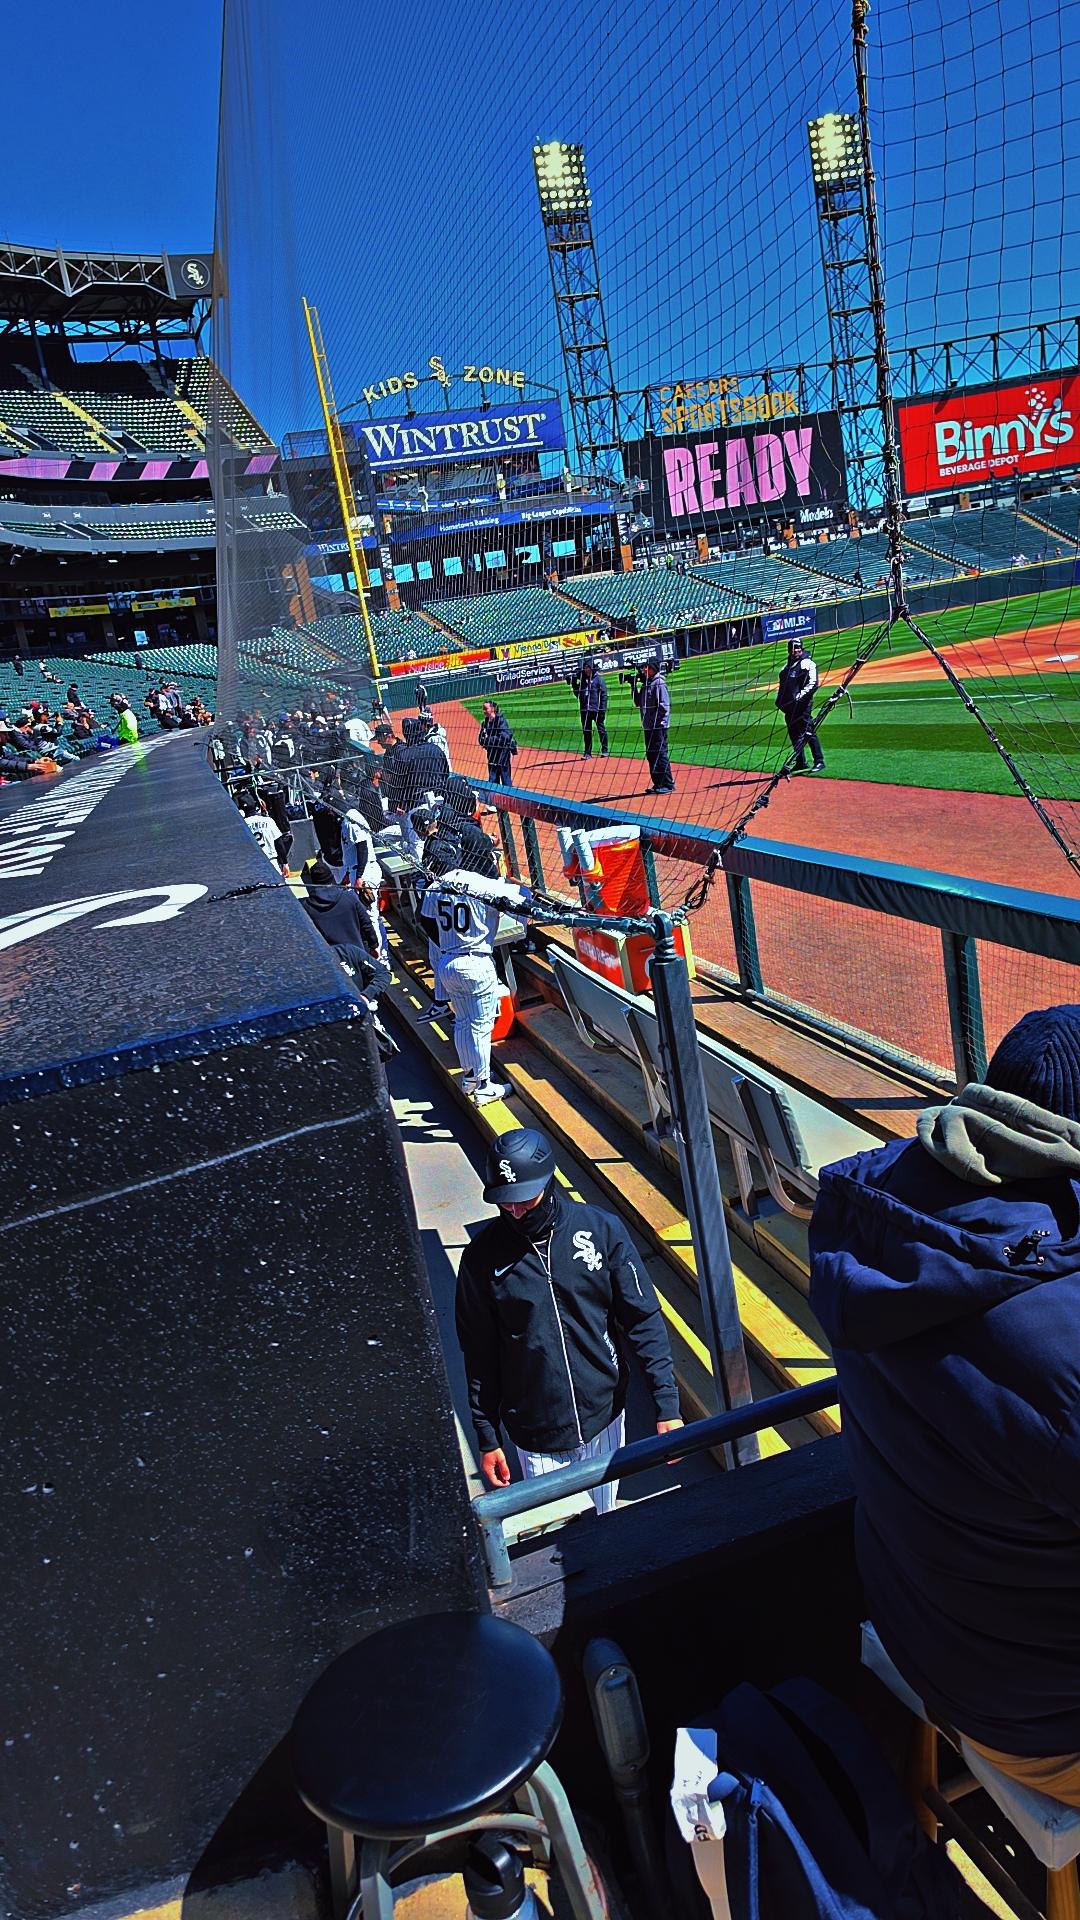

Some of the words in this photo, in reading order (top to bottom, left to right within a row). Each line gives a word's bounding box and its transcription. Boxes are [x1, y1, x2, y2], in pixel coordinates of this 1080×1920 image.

[362, 372, 419, 404] KIDS
[463, 365, 526, 388] ZONE
[661, 390, 799, 434] SPORTSBOOK
[663, 427, 813, 518] READY
[939, 459, 987, 477] BEVERAGE
[988, 453, 1021, 468] DEPOT
[437, 900, 471, 934] 50
